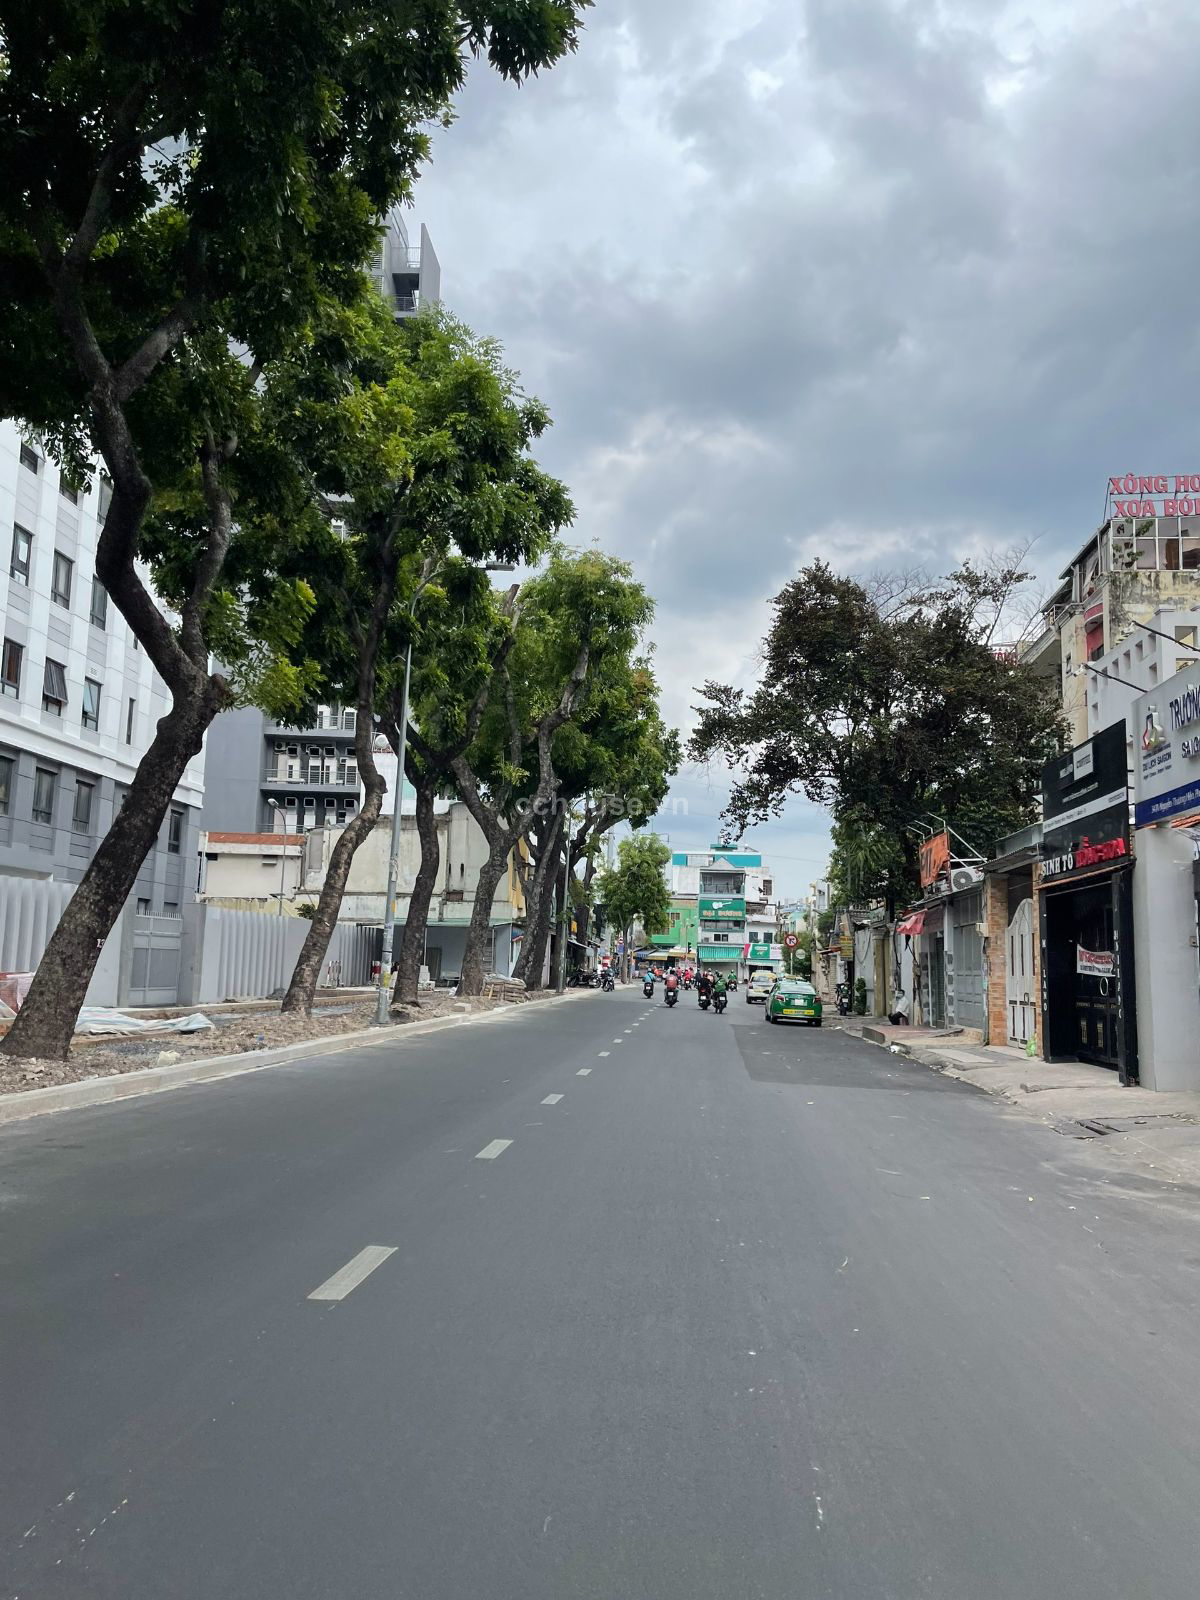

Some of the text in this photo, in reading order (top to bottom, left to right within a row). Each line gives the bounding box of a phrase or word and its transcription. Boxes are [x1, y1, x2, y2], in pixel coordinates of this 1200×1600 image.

[1109, 472, 1168, 494] XÔNG
[1114, 499, 1156, 517] XOA
[1042, 856, 1061, 876] SINH
